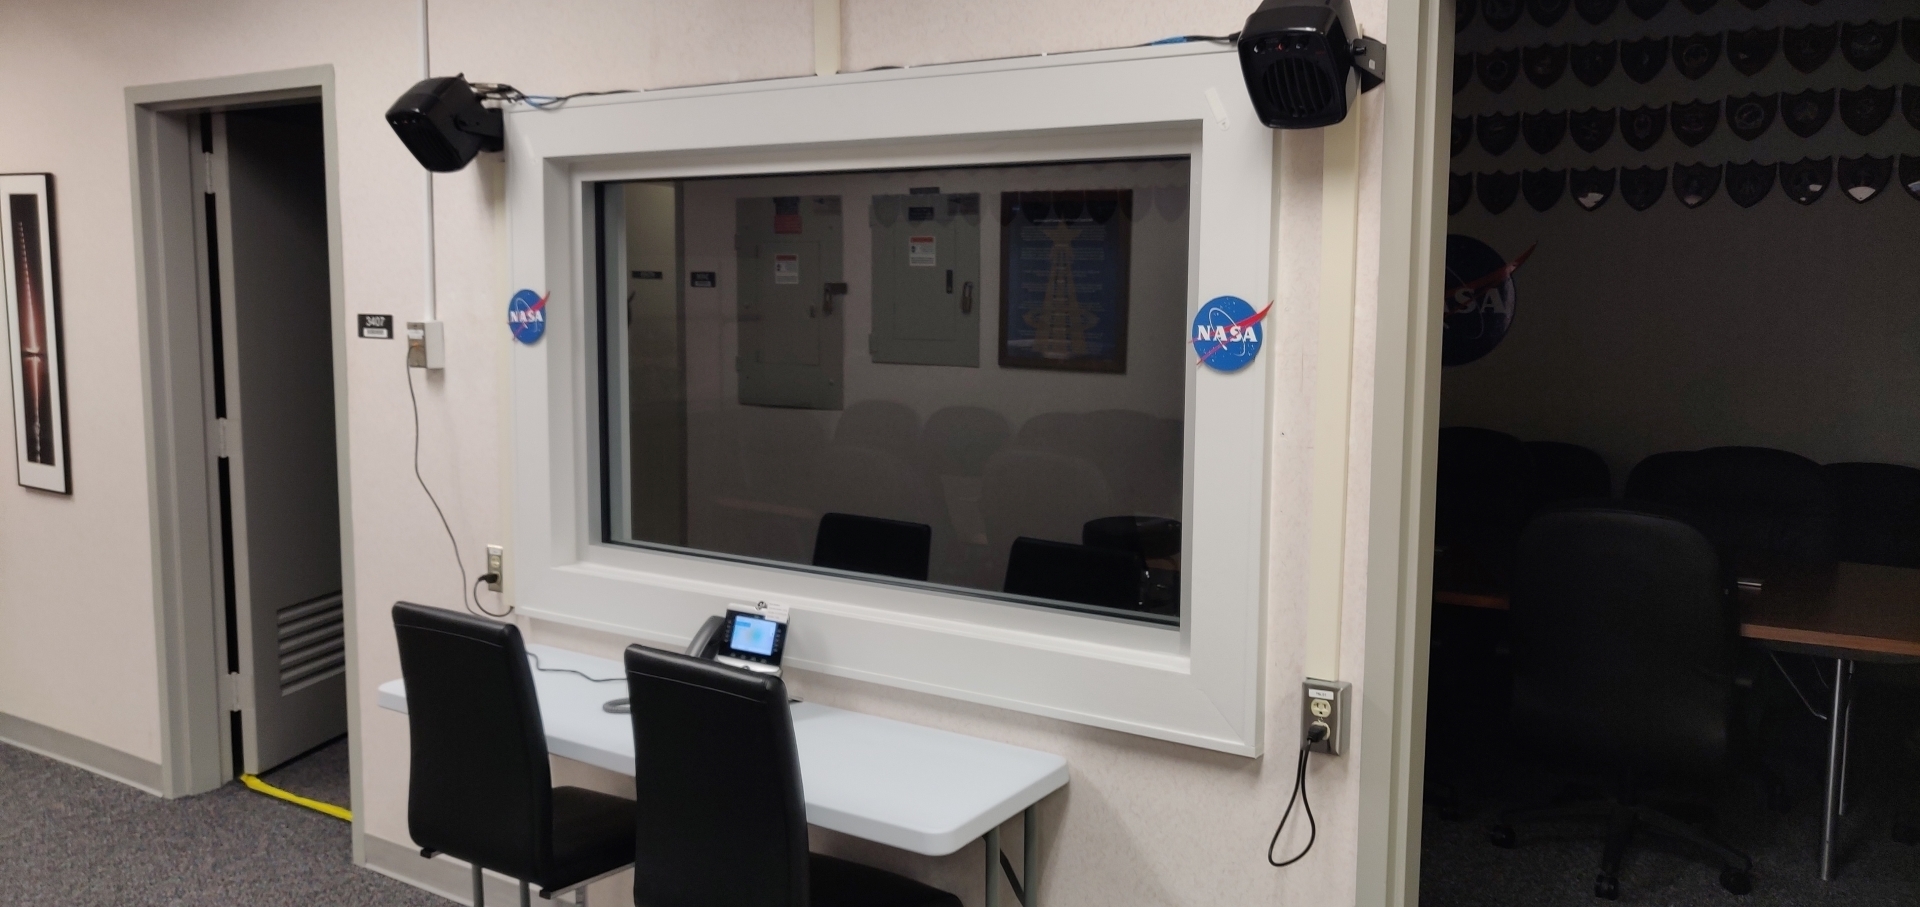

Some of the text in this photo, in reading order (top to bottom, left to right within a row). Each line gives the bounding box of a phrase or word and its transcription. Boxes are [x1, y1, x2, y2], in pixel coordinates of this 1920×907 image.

[1444, 287, 1507, 314] SA
[365, 315, 386, 327] 3407
[510, 310, 544, 322] NASA
[1197, 325, 1258, 342] NASA
